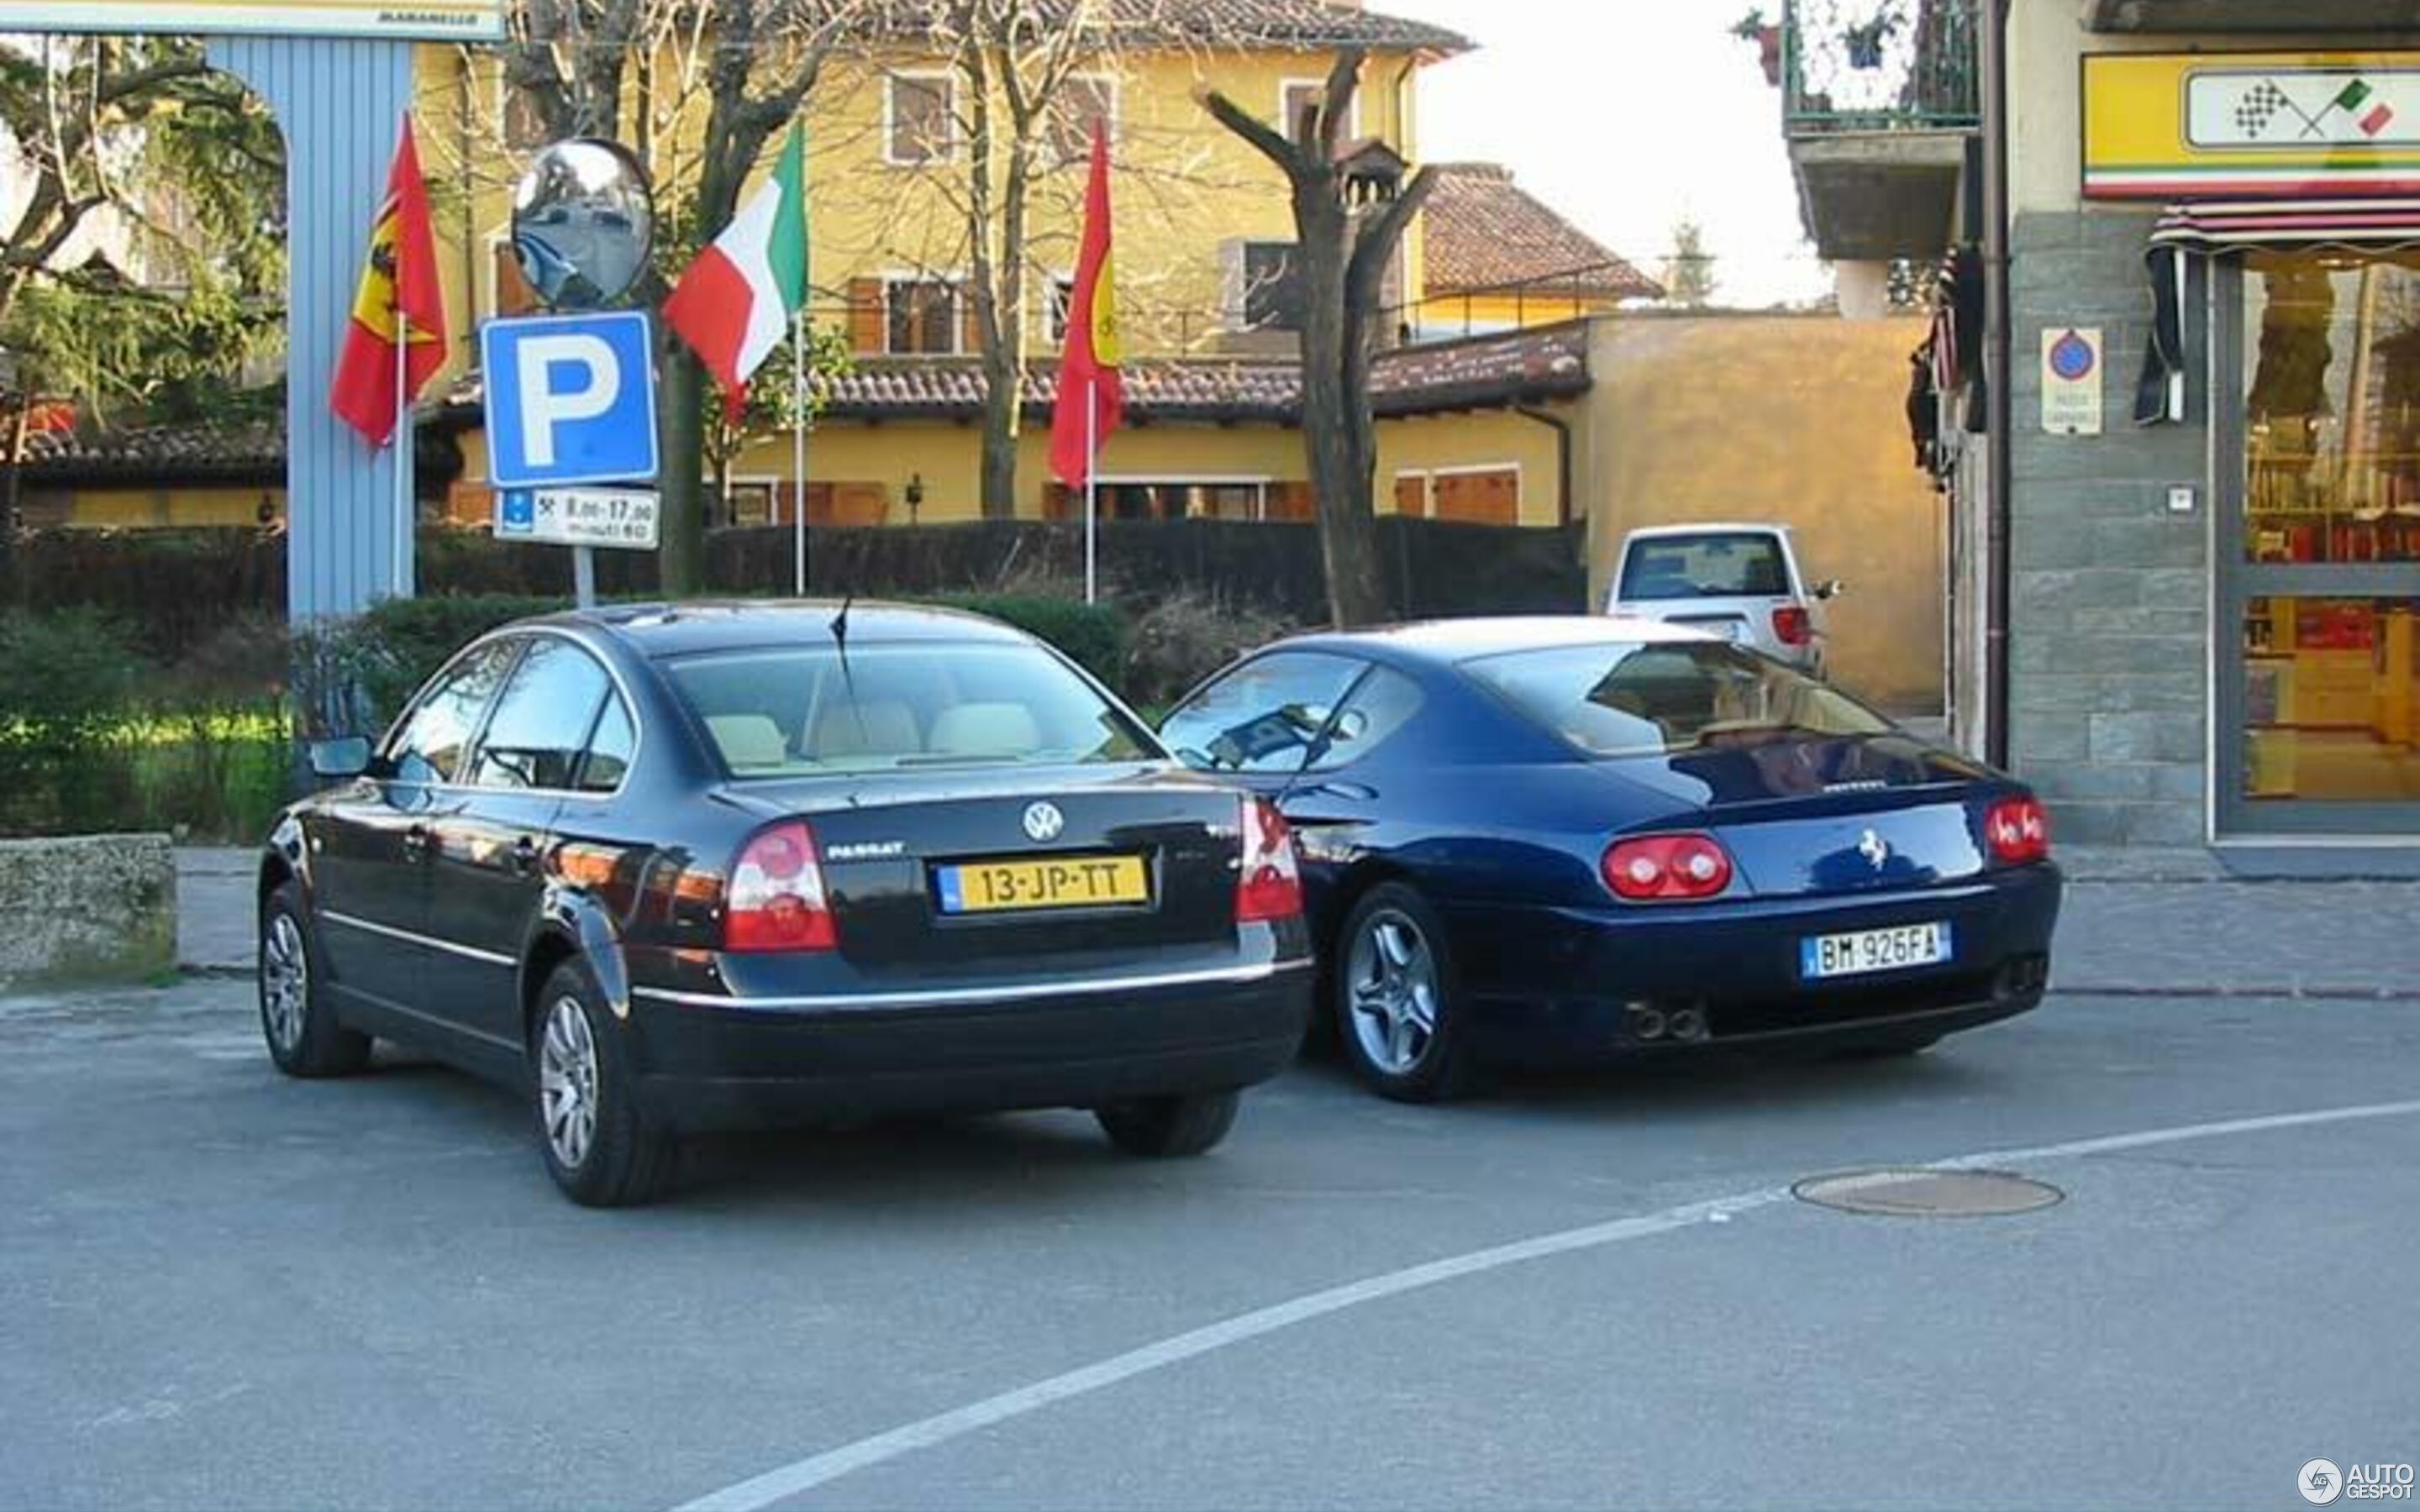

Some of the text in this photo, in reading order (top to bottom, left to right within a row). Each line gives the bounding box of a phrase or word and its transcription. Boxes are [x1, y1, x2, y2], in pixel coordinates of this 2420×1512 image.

[518, 334, 619, 466] P
[981, 864, 1120, 902] 13-JP-TT
[1822, 937, 1854, 971] BM
